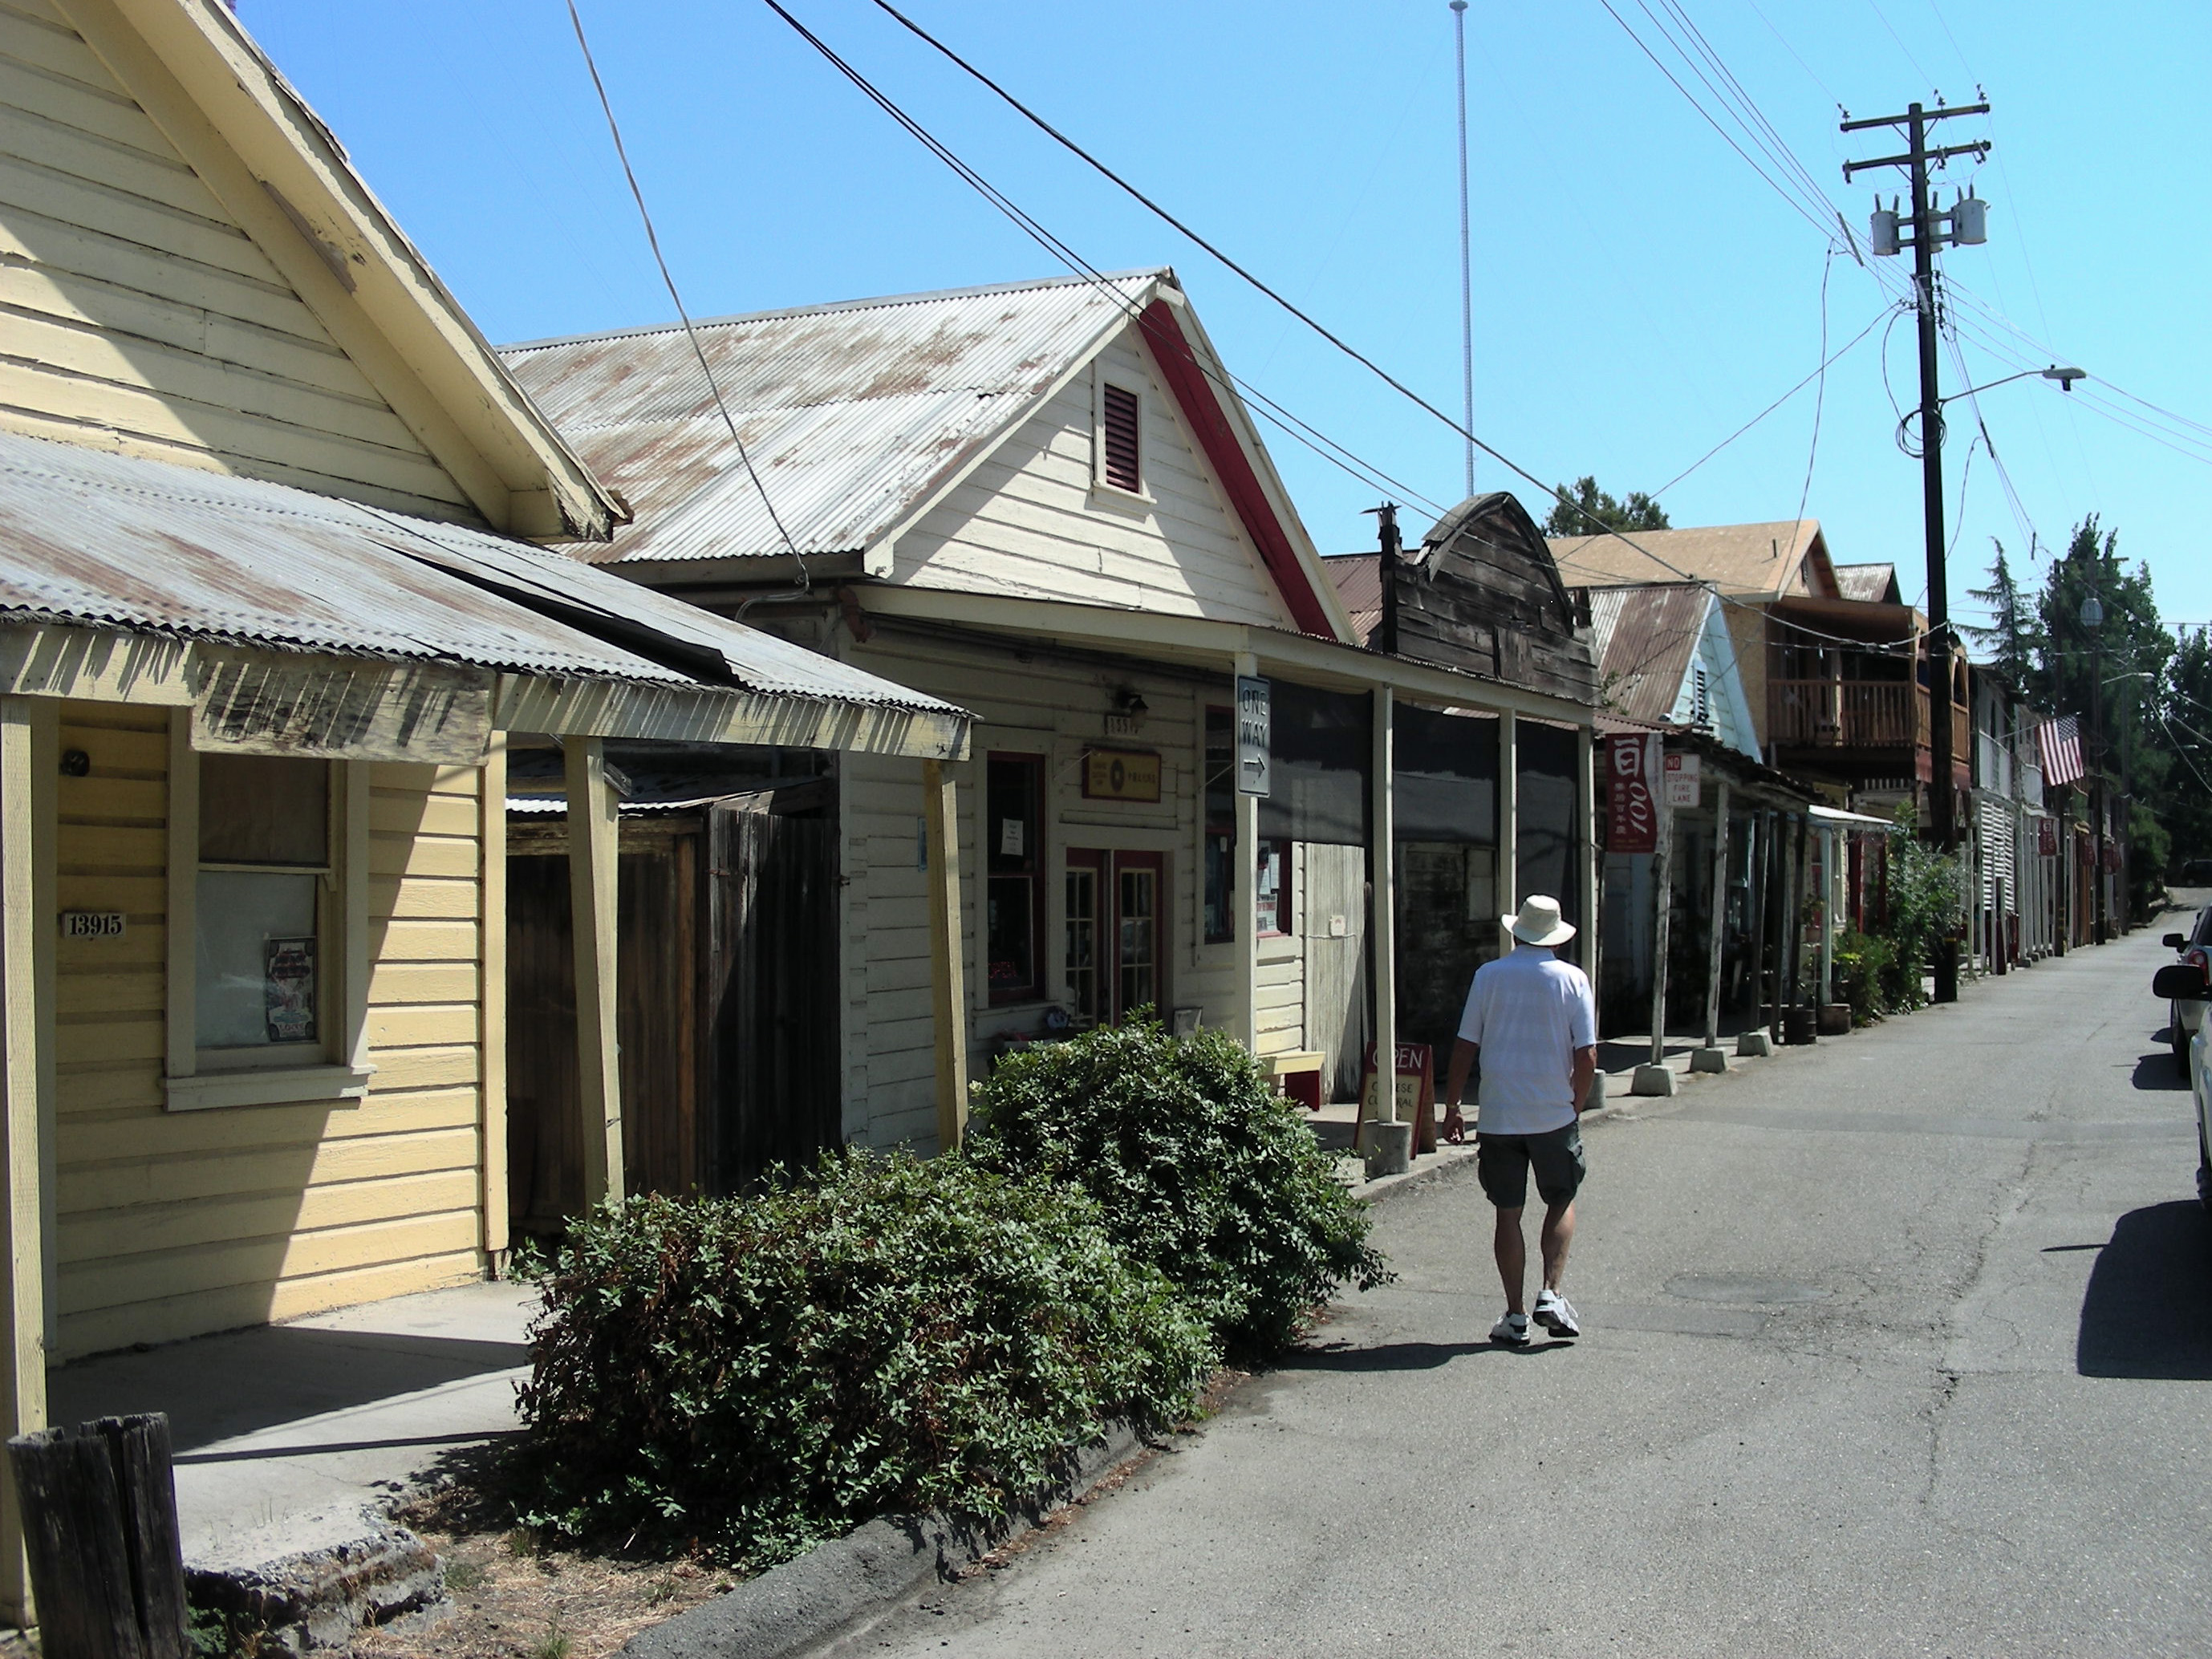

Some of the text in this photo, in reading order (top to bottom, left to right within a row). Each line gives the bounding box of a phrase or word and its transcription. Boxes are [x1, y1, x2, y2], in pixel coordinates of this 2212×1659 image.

[1243, 688, 1266, 716] ONE
[1242, 719, 1268, 747] WAY
[1666, 756, 1680, 769] NO
[1666, 773, 1698, 782] STOPPING
[1674, 784, 1690, 793] FIRE
[1673, 794, 1691, 802] LANE
[70, 915, 123, 935] 13915
[1373, 1048, 1423, 1069] EN
[1371, 1081, 1413, 1094] CESE
